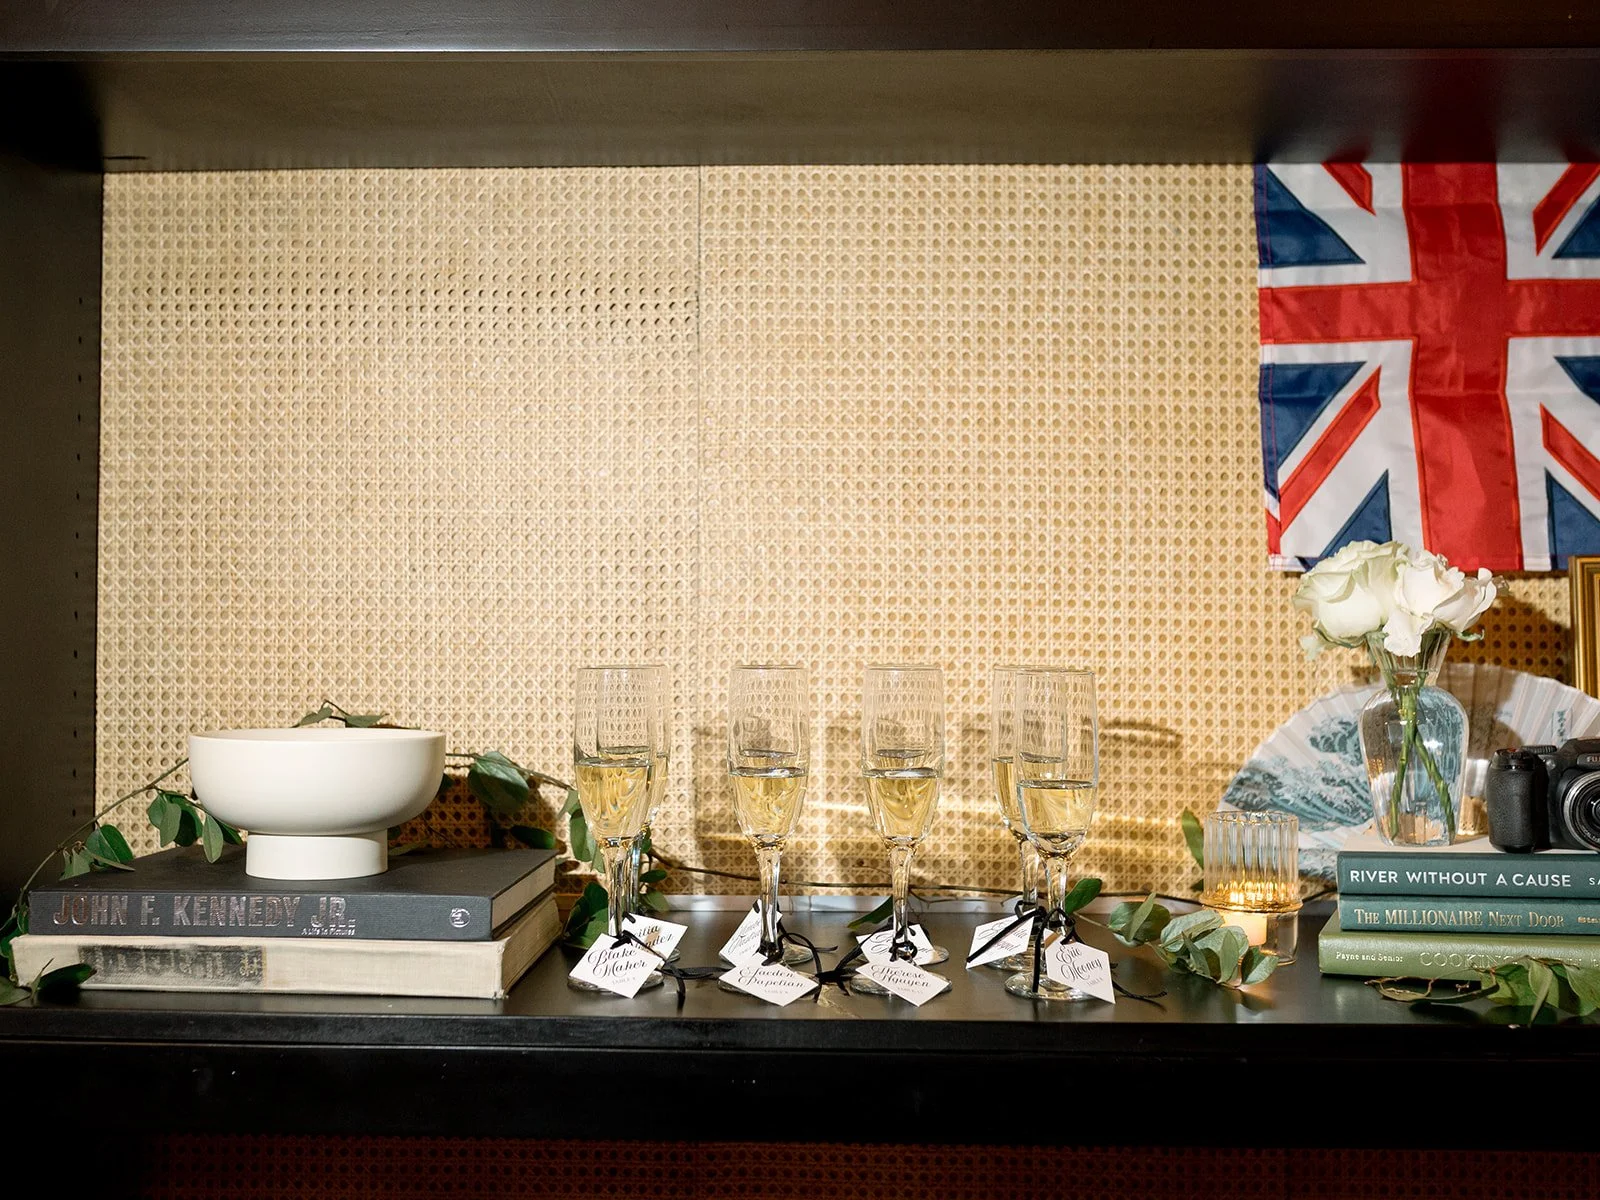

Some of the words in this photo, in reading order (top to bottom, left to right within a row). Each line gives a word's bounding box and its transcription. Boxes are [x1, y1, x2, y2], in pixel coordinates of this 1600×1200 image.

[1350, 870, 1398, 883] RIVER
[1405, 871, 1487, 885] WITHOUT
[1495, 873, 1508, 886] A
[1512, 873, 1571, 887] CAUSE
[53, 895, 128, 926] JOHN
[140, 896, 160, 926] F.
[173, 896, 301, 927] KENNEDY
[310, 897, 356, 928] JR.
[1385, 909, 1483, 927] MILLIONAIRE
[587, 947, 638, 967] Blake
[1056, 945, 1082, 964] Eric
[1336, 951, 1360, 961] Payne
[1361, 953, 1376, 961] and
[592, 960, 648, 980] Maher
[872, 971, 930, 988] Nguyen
[1060, 959, 1103, 982] Mooney
